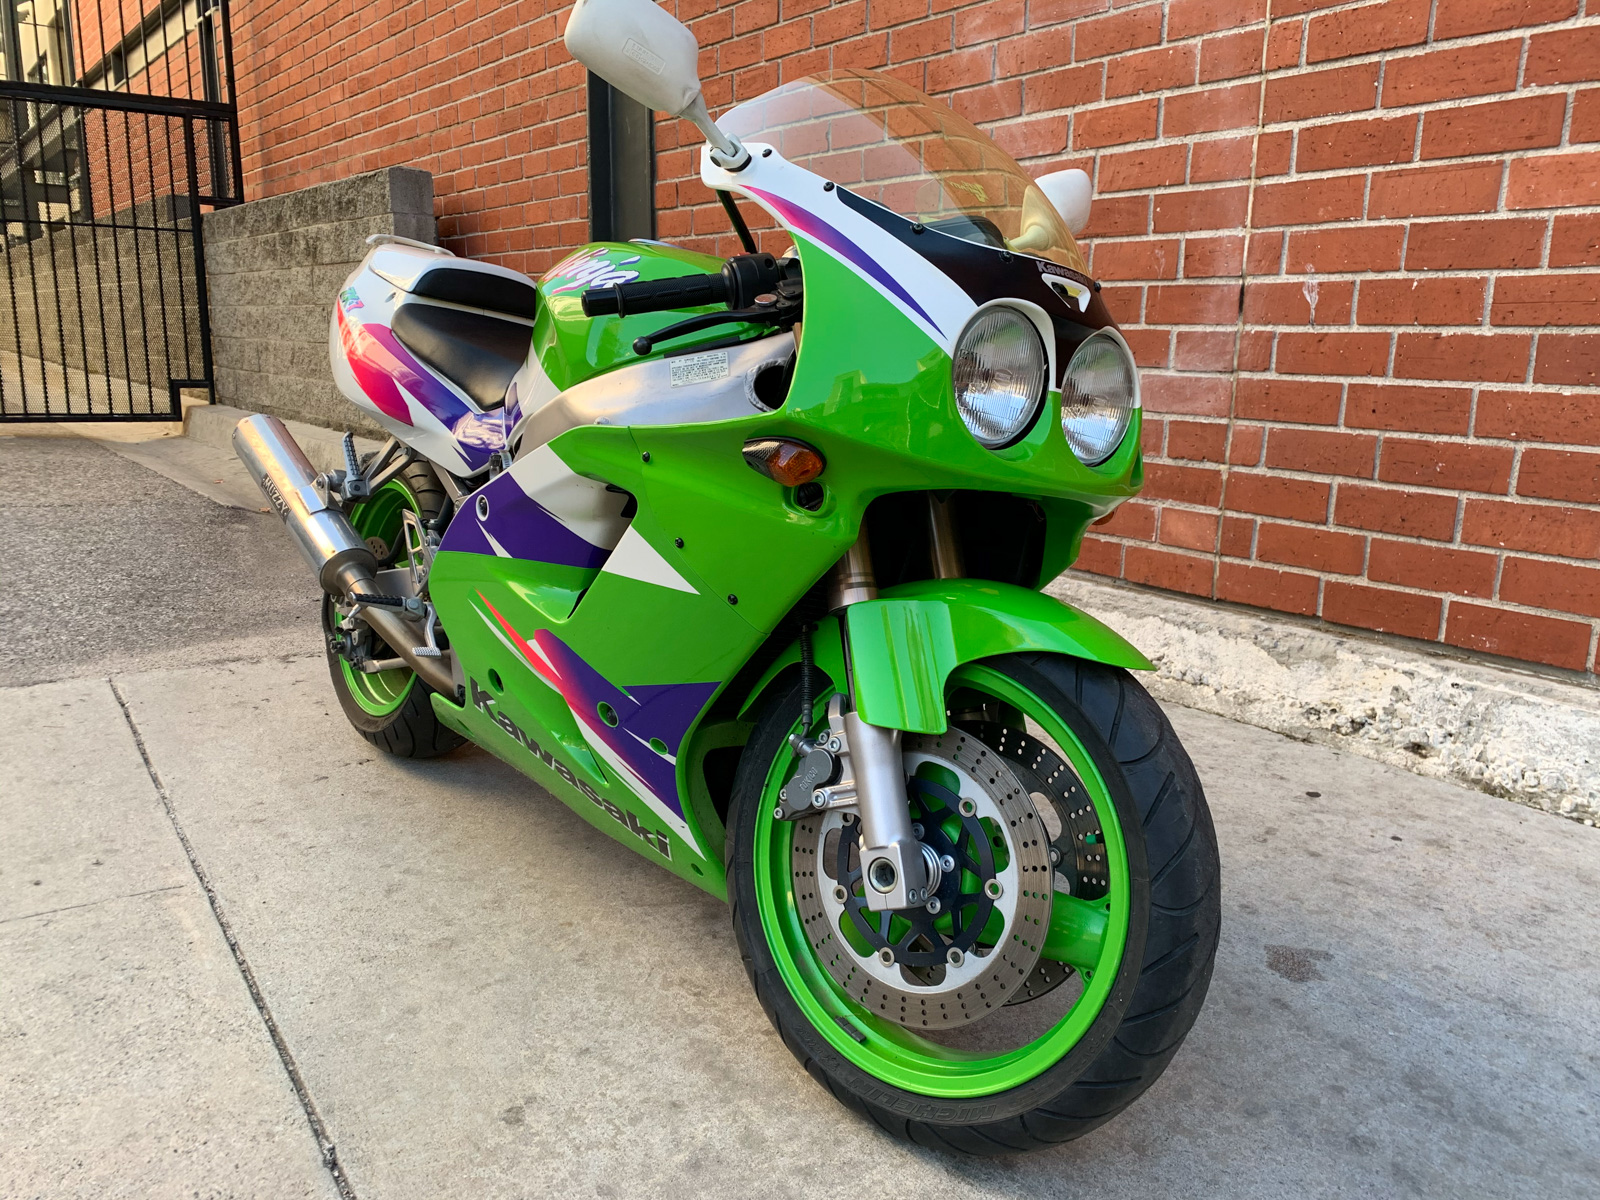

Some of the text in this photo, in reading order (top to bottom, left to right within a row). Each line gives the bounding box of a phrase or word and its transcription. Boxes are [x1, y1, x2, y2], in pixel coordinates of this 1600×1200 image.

[263, 477, 288, 515] MUZZY
[469, 676, 673, 862] Kawasaki
[799, 766, 818, 792] TOKICO
[851, 1077, 997, 1122] MICHELIN
